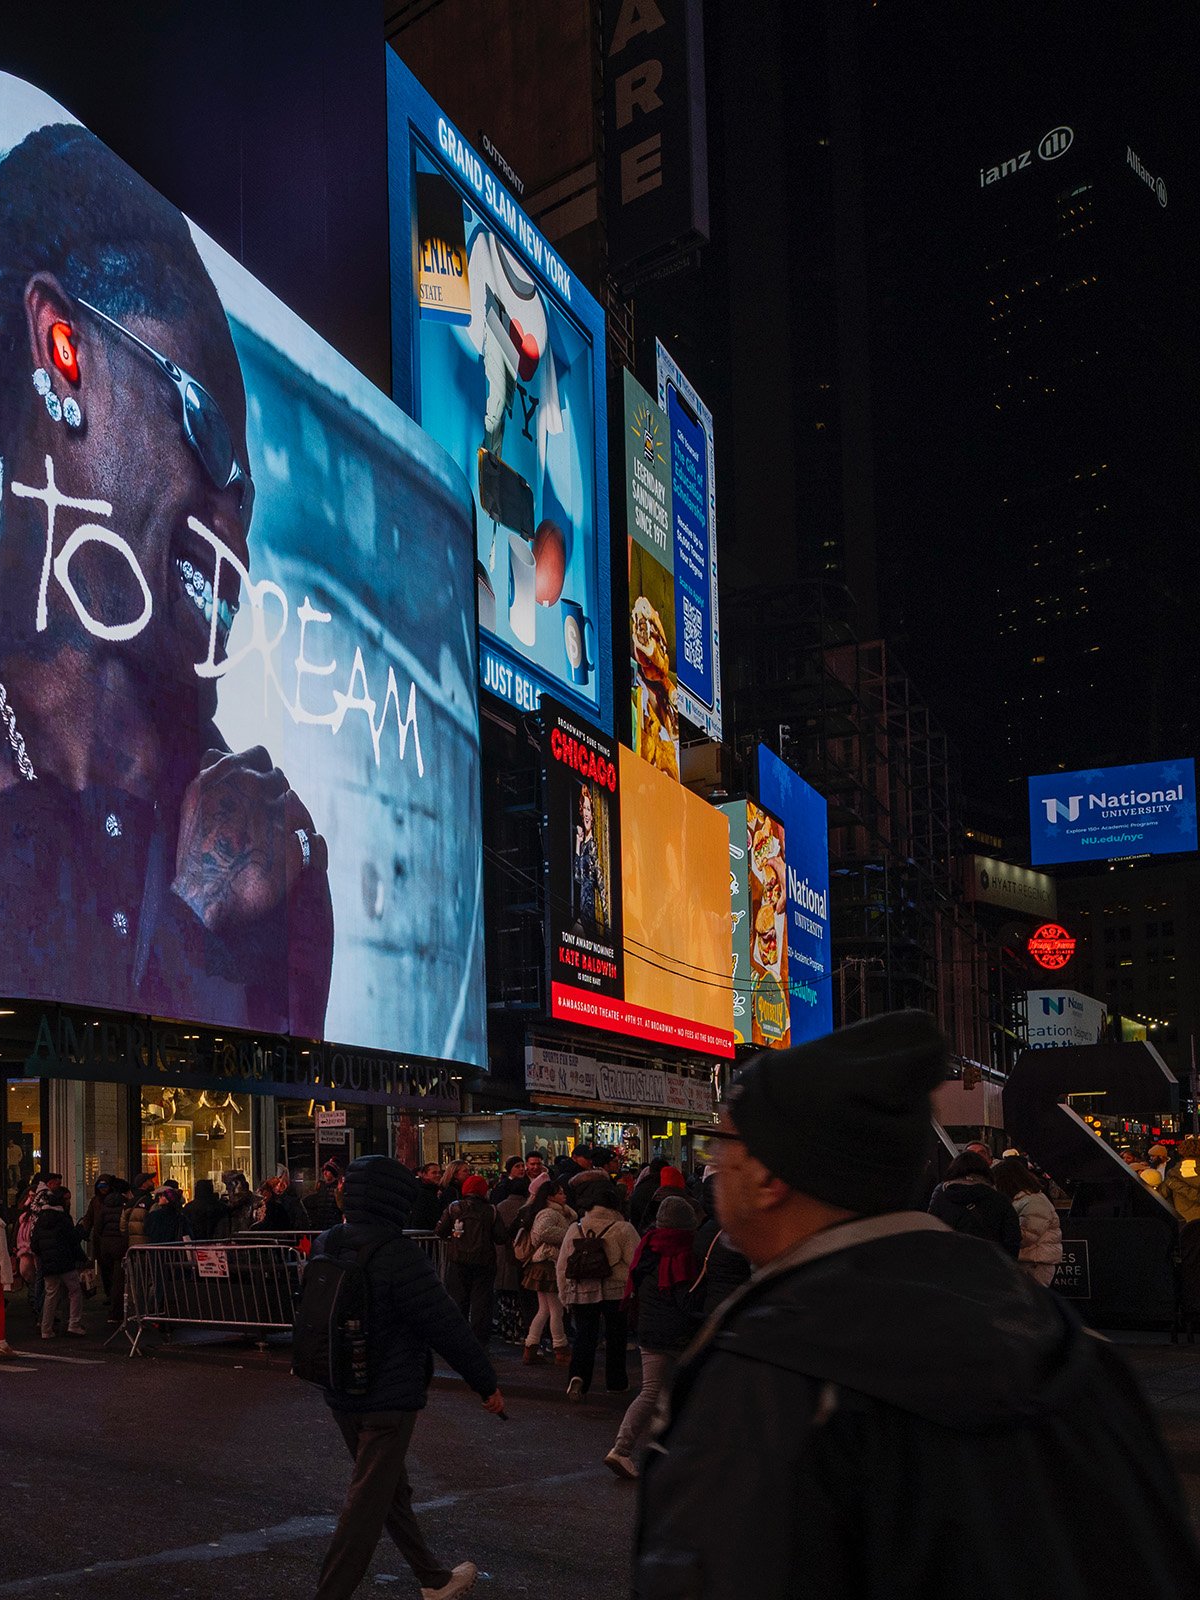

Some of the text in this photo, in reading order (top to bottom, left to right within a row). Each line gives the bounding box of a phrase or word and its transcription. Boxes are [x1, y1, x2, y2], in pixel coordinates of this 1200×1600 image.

[980, 151, 1032, 188] ianz
[1126, 145, 1156, 192] Allianz
[438, 117, 571, 301] GRAND SLAM NEW YORK
[419, 236, 463, 277] ENIRS
[420, 283, 443, 301] STATE
[633, 456, 665, 505] LEGENDARY
[674, 441, 685, 466] The
[685, 457, 696, 480] Gift
[673, 477, 706, 528] Scholarship
[675, 461, 703, 506] Education
[632, 479, 668, 530] SANDWICHES
[635, 505, 666, 551] SINCE 1977
[187, 515, 424, 777] DREAM
[484, 656, 512, 699] JUST
[558, 716, 610, 757] BROADWAY'S SURE THING
[551, 727, 616, 792] CHICAGO
[1089, 784, 1183, 810] National
[1101, 804, 1171, 819] UNIVERSITY
[1066, 827, 1087, 835] Explore
[1101, 823, 1129, 831] Academic
[1131, 820, 1159, 829] Programs
[1081, 832, 1144, 845] NU.edu/nyc
[788, 865, 827, 920] National
[992, 876, 1016, 893] HYATT
[562, 931, 576, 945] TONY
[593, 943, 614, 958] NOMINEE
[794, 910, 824, 939] UNIVERSITY
[1041, 928, 1063, 938] HOT
[559, 946, 617, 979] KATE BALDWIN
[562, 997, 598, 1015] AMBASSADOR
[599, 1006, 620, 1021] THEATRE
[624, 1014, 636, 1025] 49TH
[651, 1020, 674, 1034] BROADWAY
[677, 1027, 685, 1037] NO
[685, 1029, 695, 1040] FEES
[715, 1037, 728, 1048] OFFICE
[331, 1053, 461, 1101] OUTFITTERS
[1056, 1266, 1082, 1276] ARE
